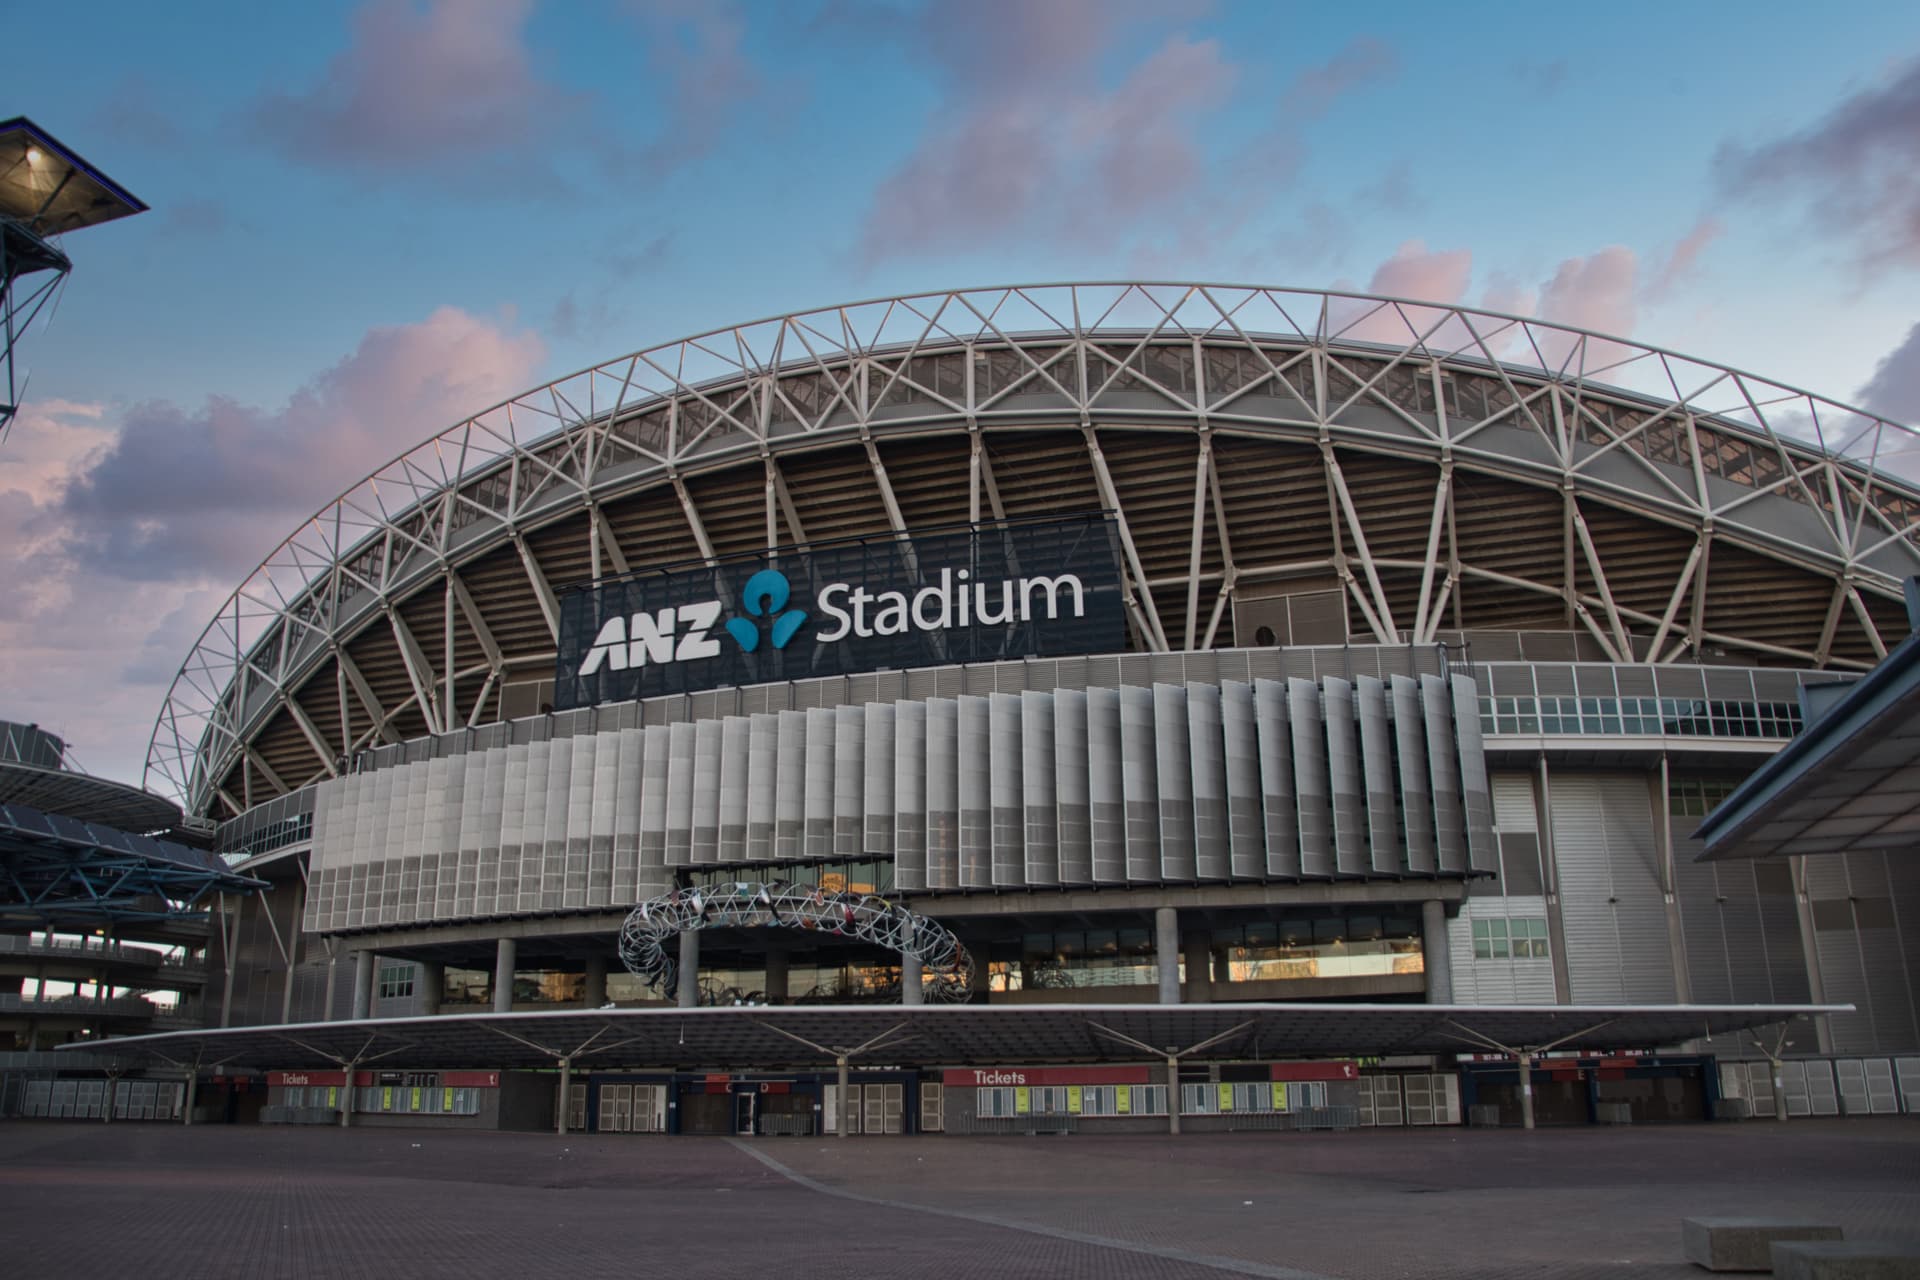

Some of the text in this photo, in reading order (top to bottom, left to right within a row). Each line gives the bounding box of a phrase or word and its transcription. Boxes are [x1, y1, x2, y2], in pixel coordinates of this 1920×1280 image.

[577, 567, 1085, 676] ANZ Stadium
[282, 1073, 308, 1085] Tickets
[974, 1070, 1026, 1084] Tickets
